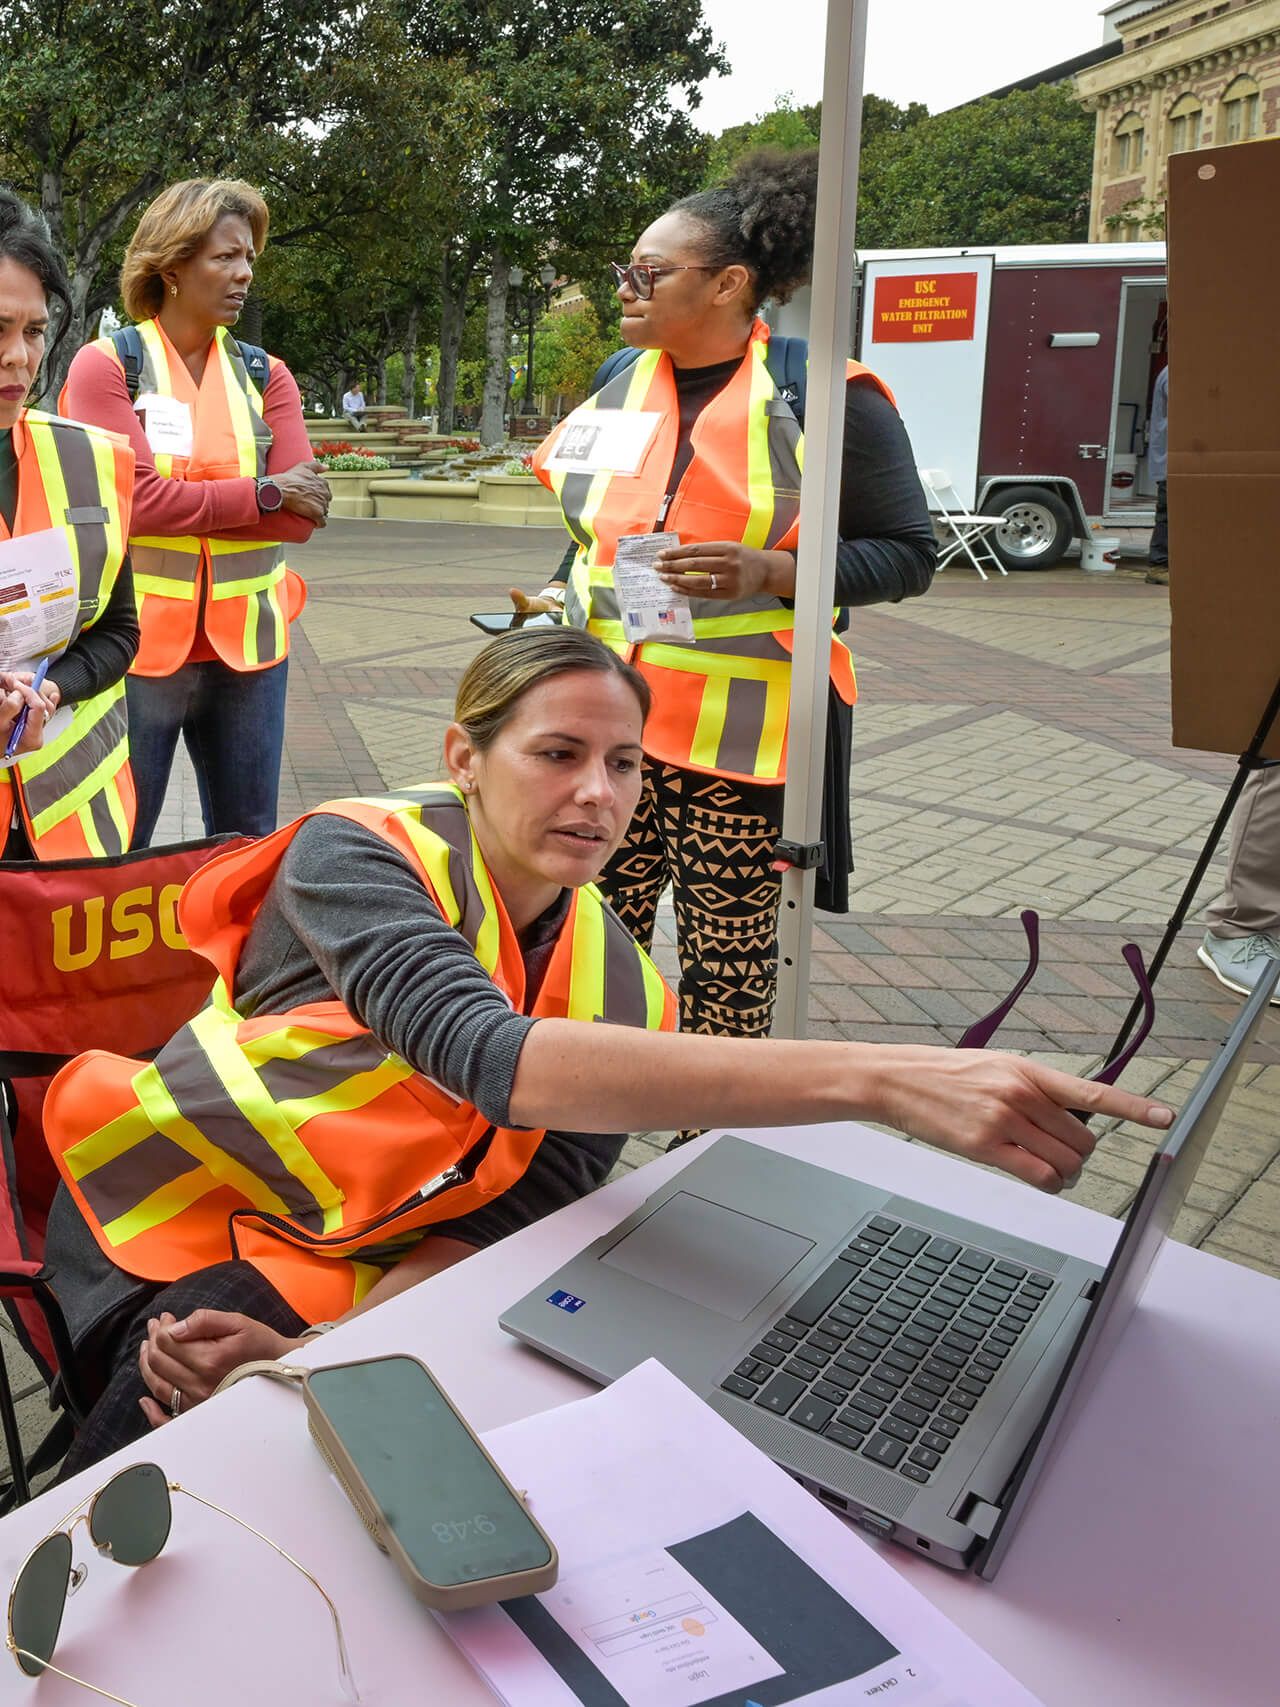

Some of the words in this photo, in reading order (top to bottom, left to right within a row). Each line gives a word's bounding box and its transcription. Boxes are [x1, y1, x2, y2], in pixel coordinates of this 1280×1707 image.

[915, 281, 937, 294] USC
[899, 297, 950, 309] EMERGENCY
[881, 312, 912, 322] WATER
[915, 310, 968, 320] FILTRATION
[913, 324, 933, 333] UNIT
[51, 884, 190, 972] USC
[431, 1514, 497, 1543] 9:48
[687, 1669, 711, 1682] Login
[905, 1668, 917, 1677] 2
